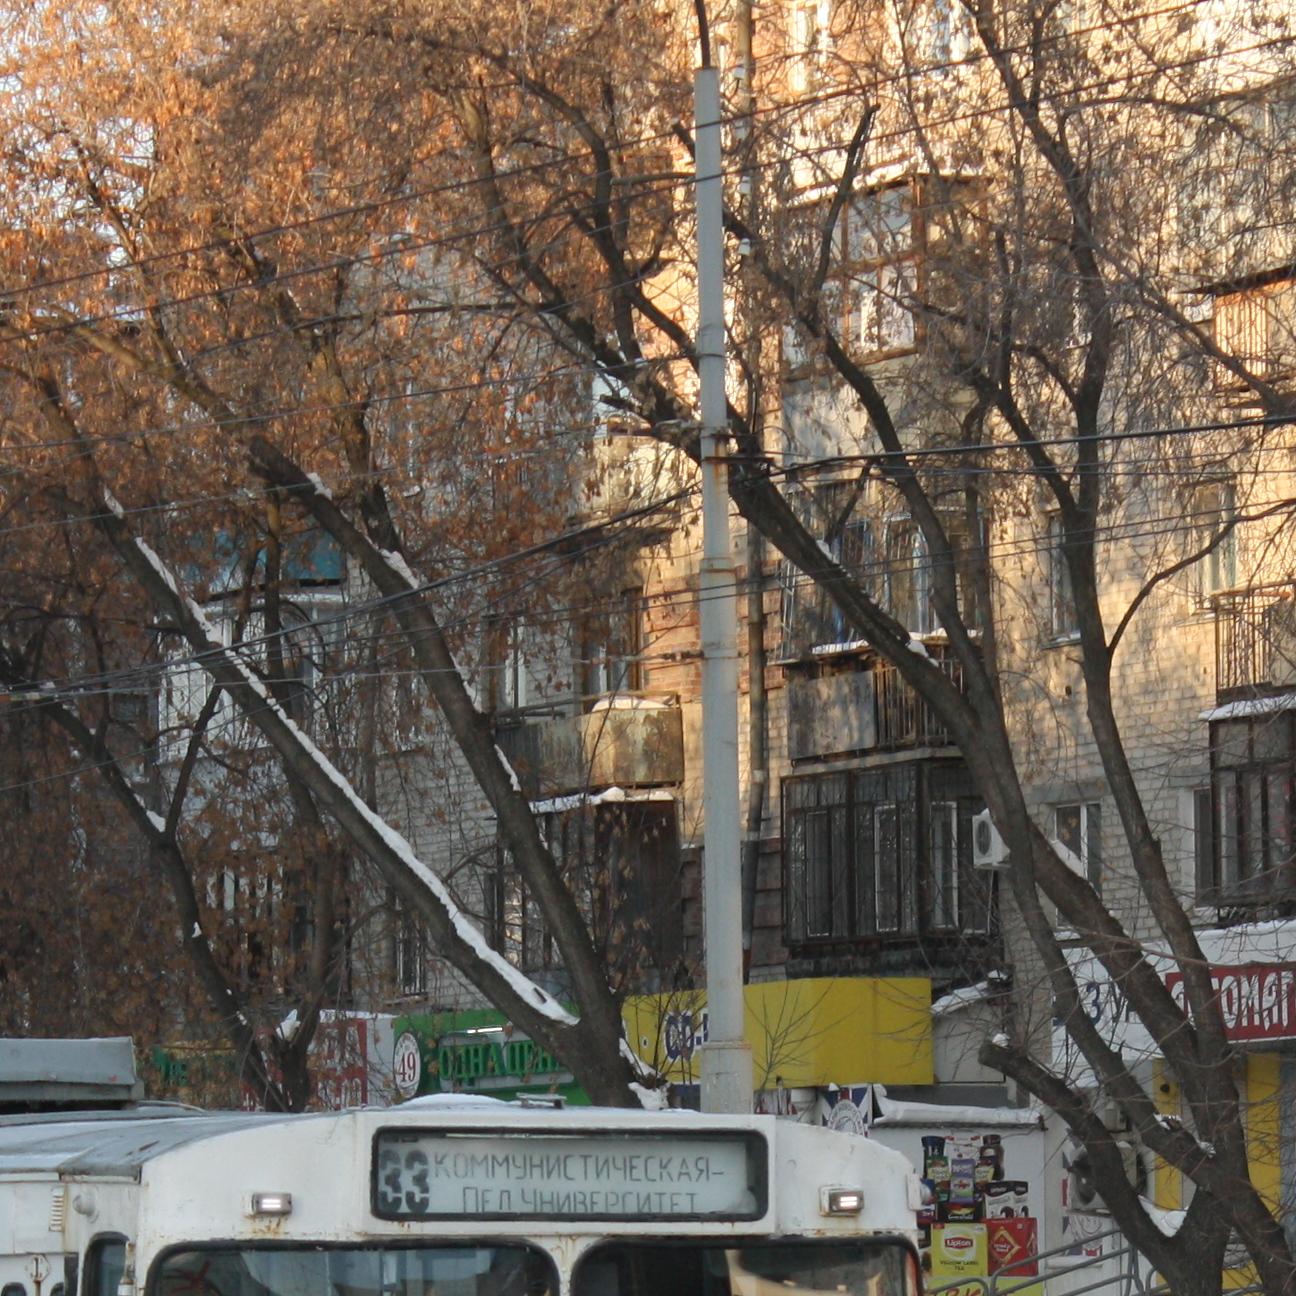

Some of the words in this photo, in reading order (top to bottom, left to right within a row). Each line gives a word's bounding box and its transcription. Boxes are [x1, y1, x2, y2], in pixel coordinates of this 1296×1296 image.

[397, 1051, 417, 1083] 49
[379, 1149, 431, 1214] 33
[947, 1239, 971, 1248] Lipton
